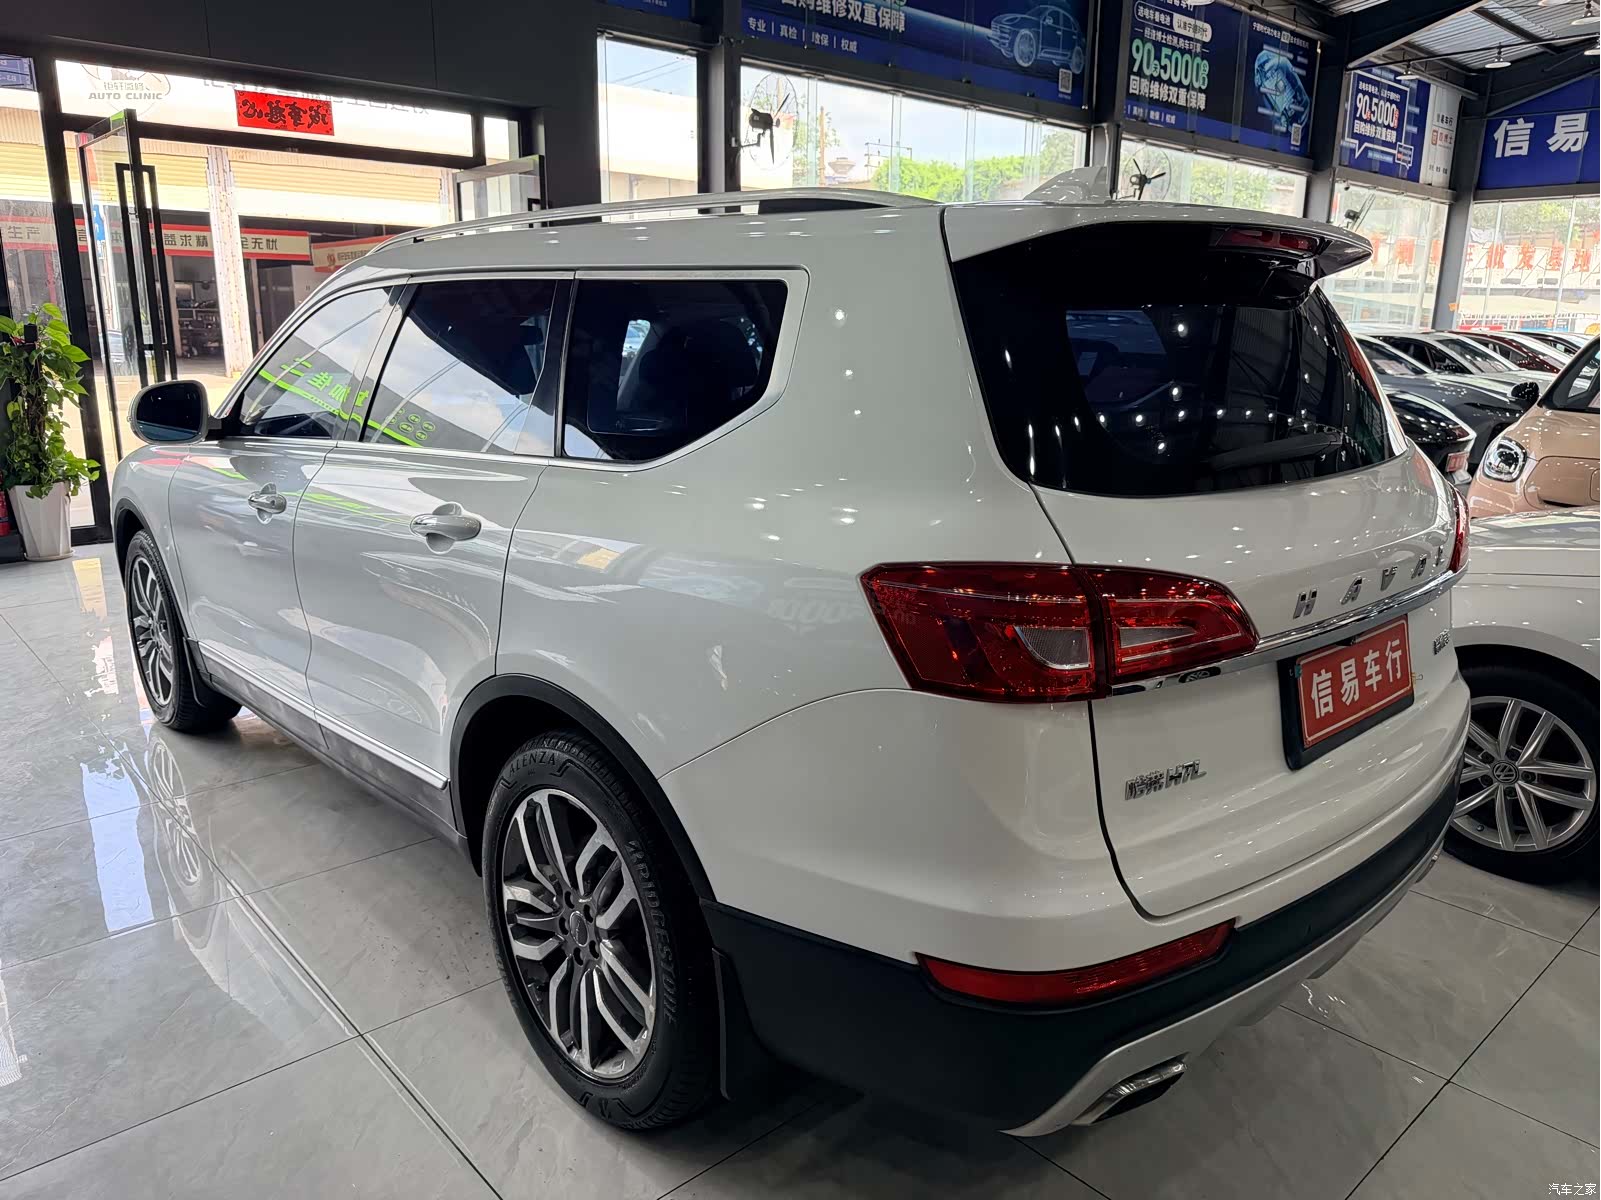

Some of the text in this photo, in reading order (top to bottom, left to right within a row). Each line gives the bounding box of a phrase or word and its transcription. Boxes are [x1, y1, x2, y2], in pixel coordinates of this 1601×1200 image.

[747, 17, 767, 33] 专业
[840, 38, 858, 54] 权威
[88, 92, 163, 100] AUTO CLINIC
[1129, 75, 1207, 111] 回购维修双重保障
[1493, 113, 1589, 157] 信易
[1310, 638, 1403, 720] 信易车行
[509, 751, 557, 777] ALENZA
